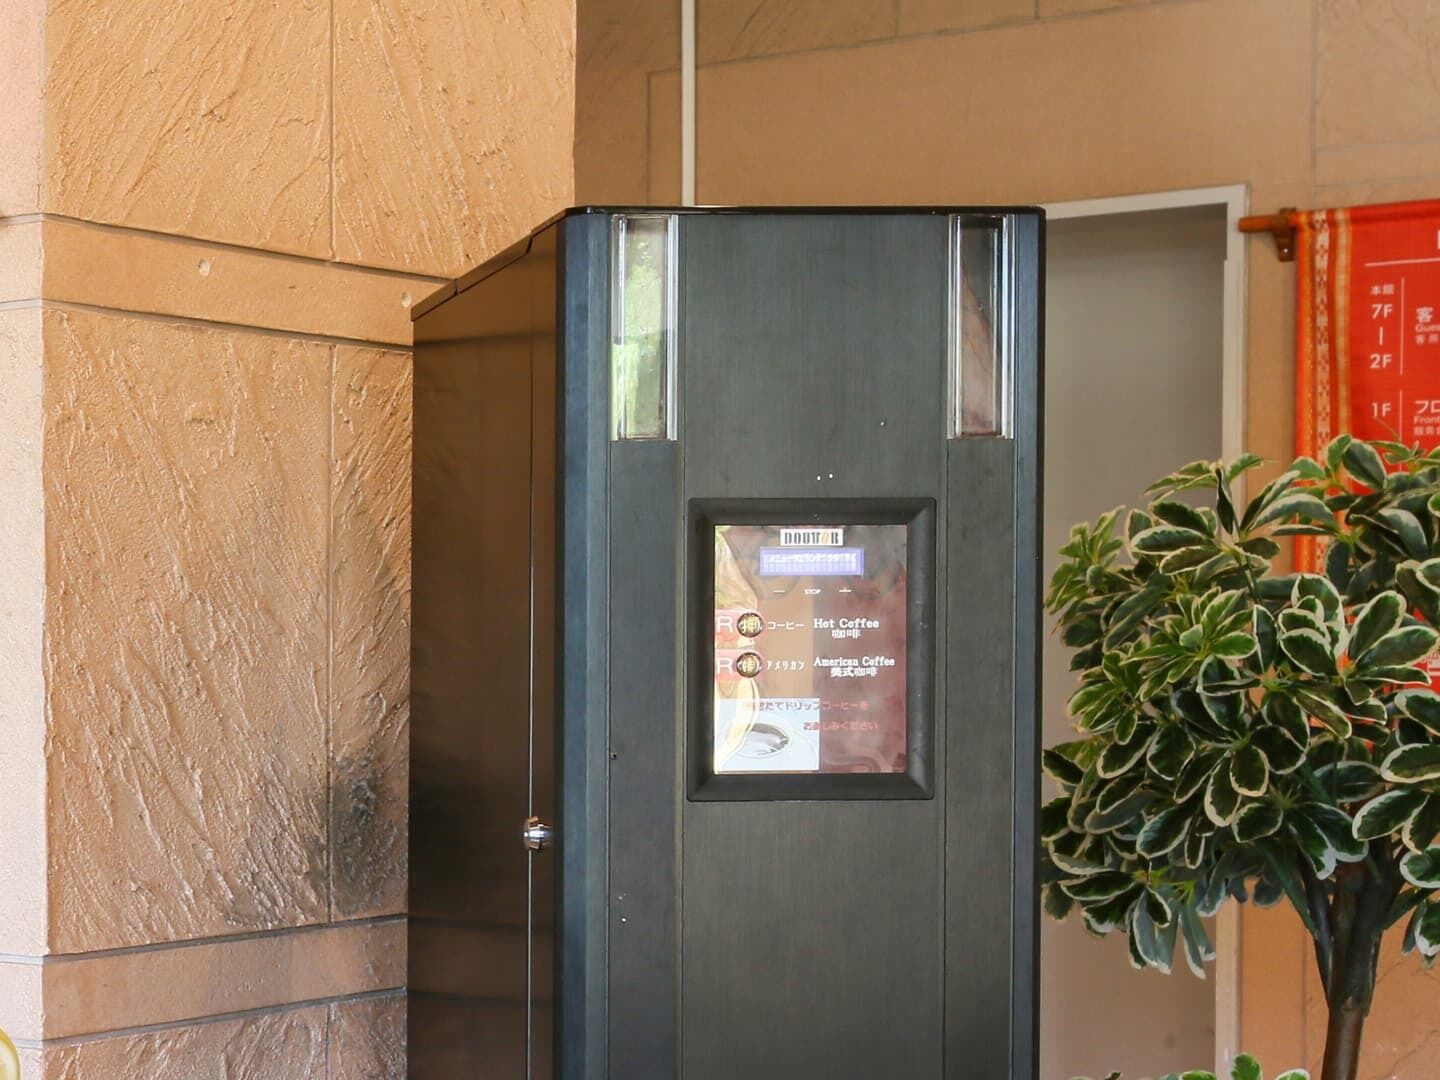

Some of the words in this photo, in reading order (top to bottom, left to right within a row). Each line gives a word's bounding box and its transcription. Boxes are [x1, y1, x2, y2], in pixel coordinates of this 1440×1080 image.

[1371, 303, 1393, 319] 7F
[1370, 354, 1392, 369] 2F
[1371, 403, 1392, 417] 1F
[767, 620, 805, 630] コーヒー
[813, 618, 835, 629] Hot
[839, 618, 880, 629] Coffee
[767, 660, 805, 671] アメリカン
[813, 657, 859, 667] American
[862, 656, 896, 667] Coffee
